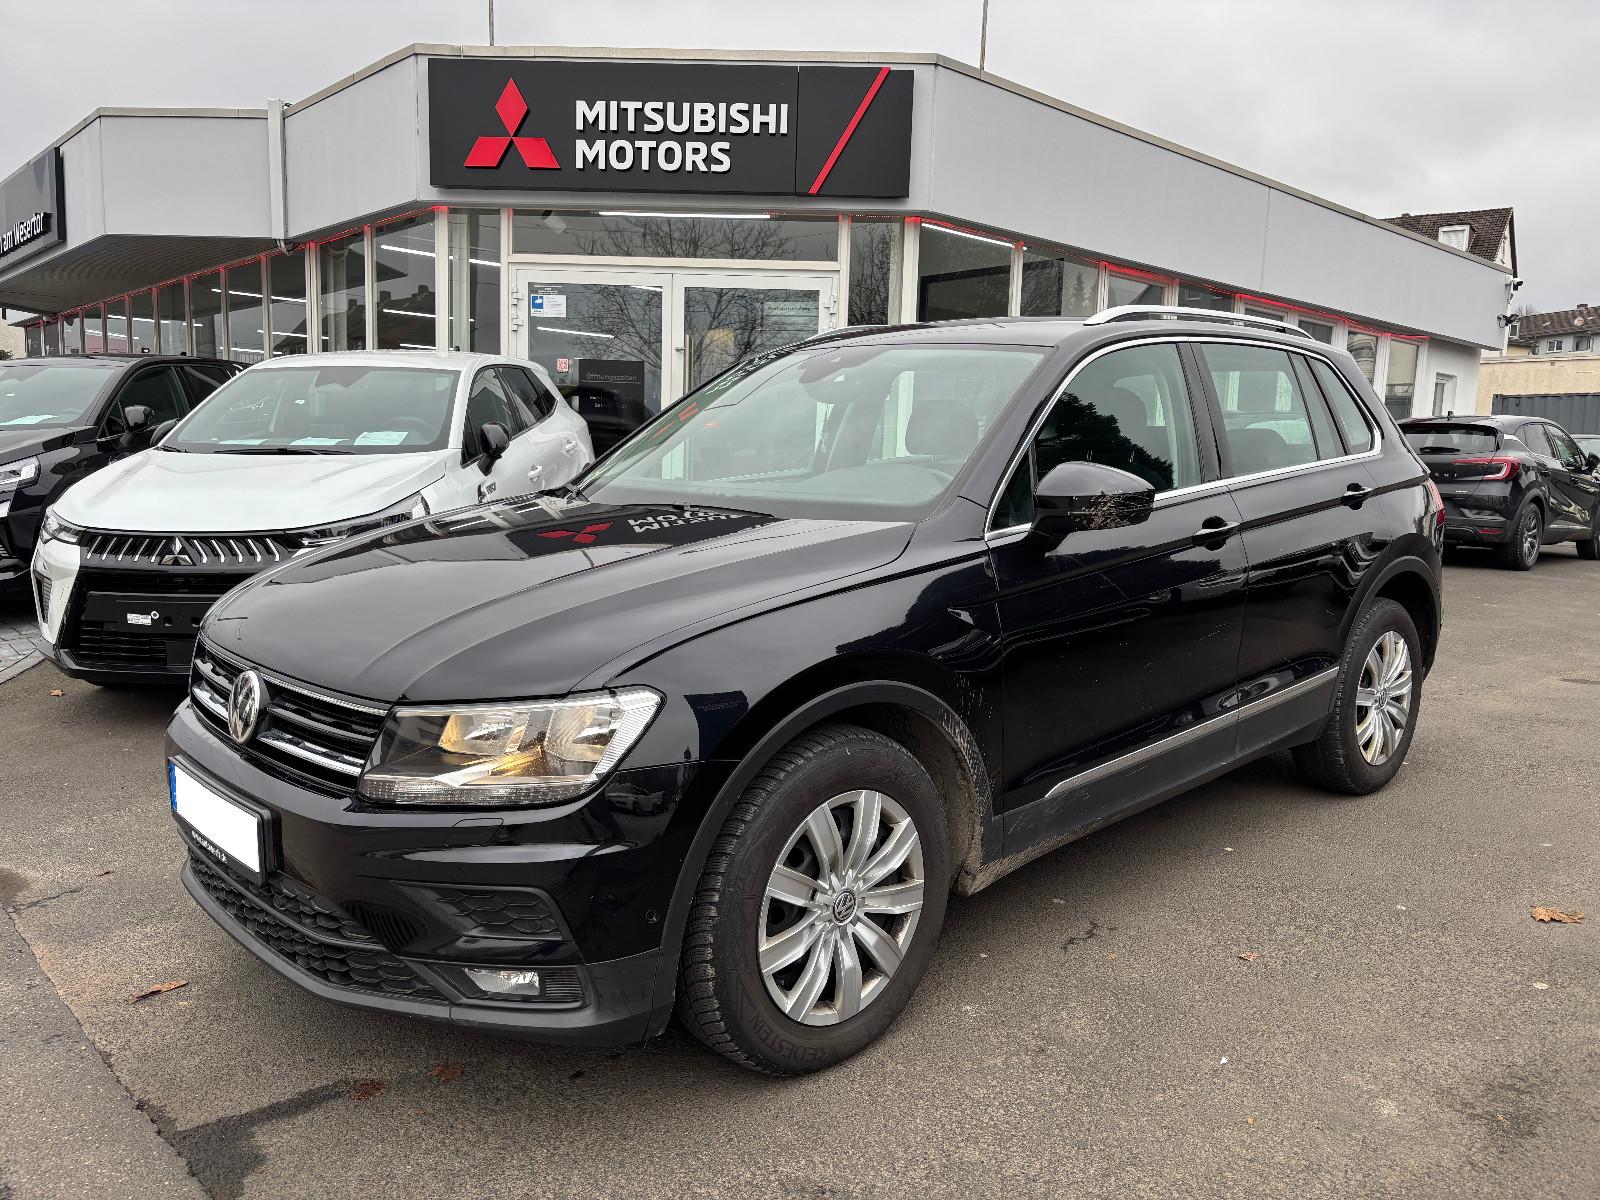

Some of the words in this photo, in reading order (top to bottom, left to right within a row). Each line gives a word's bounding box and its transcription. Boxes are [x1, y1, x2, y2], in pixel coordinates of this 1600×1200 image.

[576, 100, 788, 134] MITSUBISHI
[576, 139, 731, 172] MOTORS
[3, 230, 14, 252] am
[13, 211, 44, 246] Wesertor
